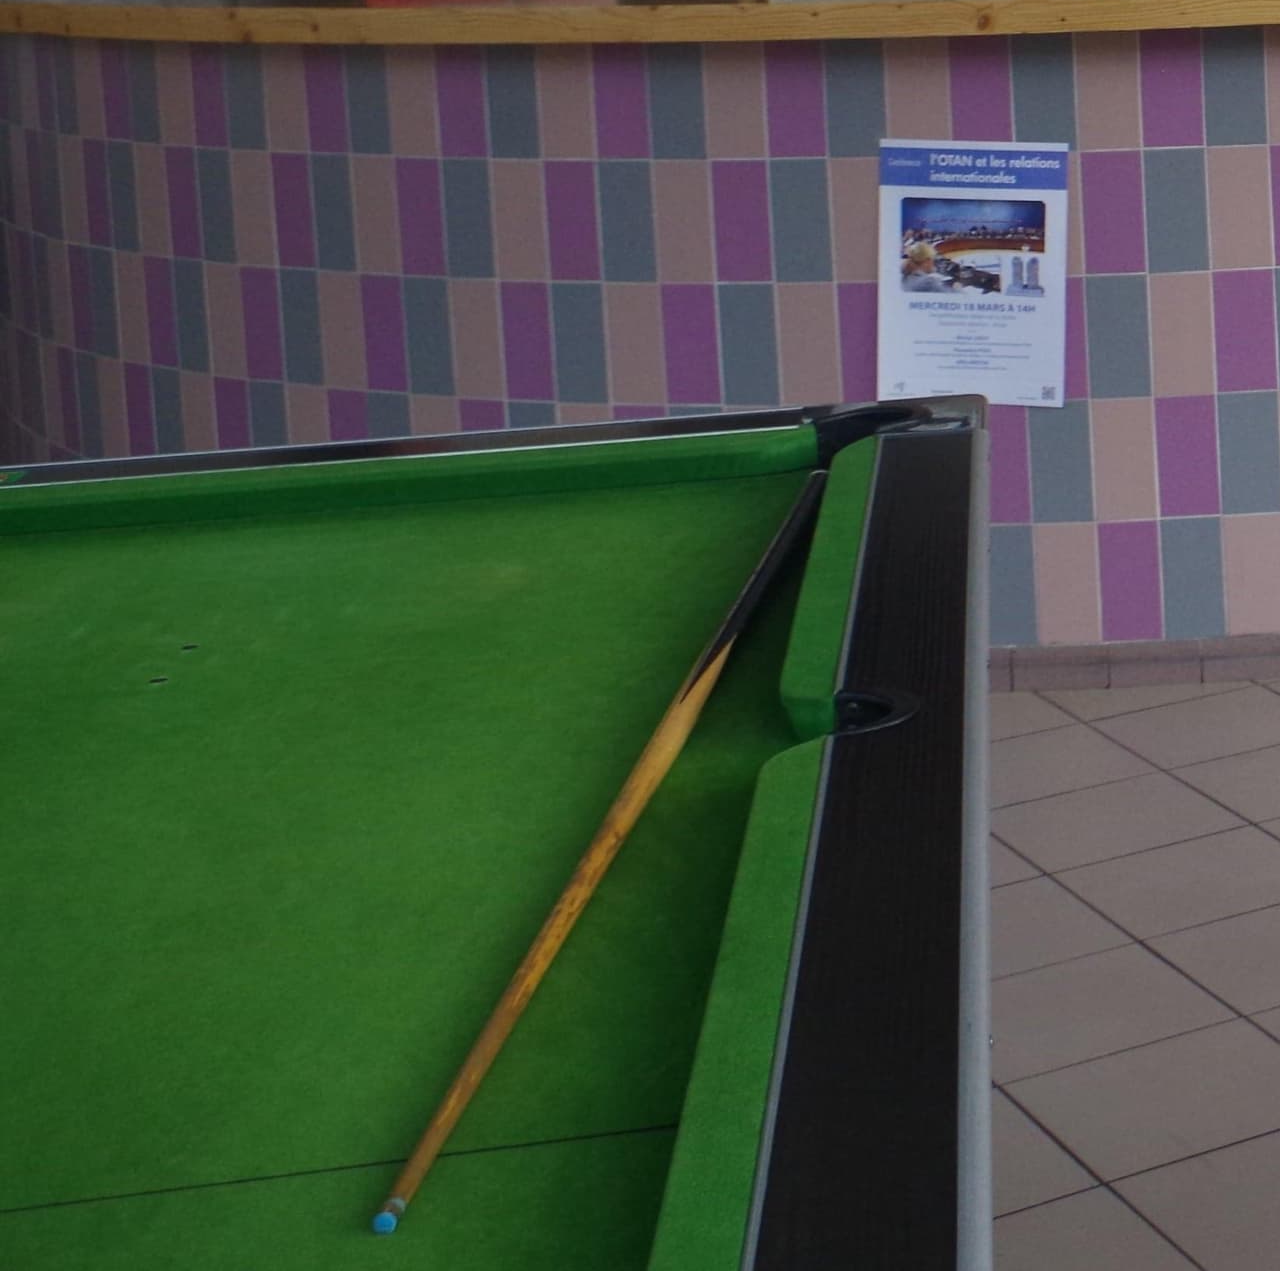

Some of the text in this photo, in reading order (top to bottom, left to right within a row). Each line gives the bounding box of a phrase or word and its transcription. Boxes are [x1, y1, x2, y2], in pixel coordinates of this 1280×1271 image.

[975, 155, 987, 167] et
[990, 155, 1006, 168] les
[1009, 155, 1061, 169] relations
[929, 169, 1017, 184] internationales
